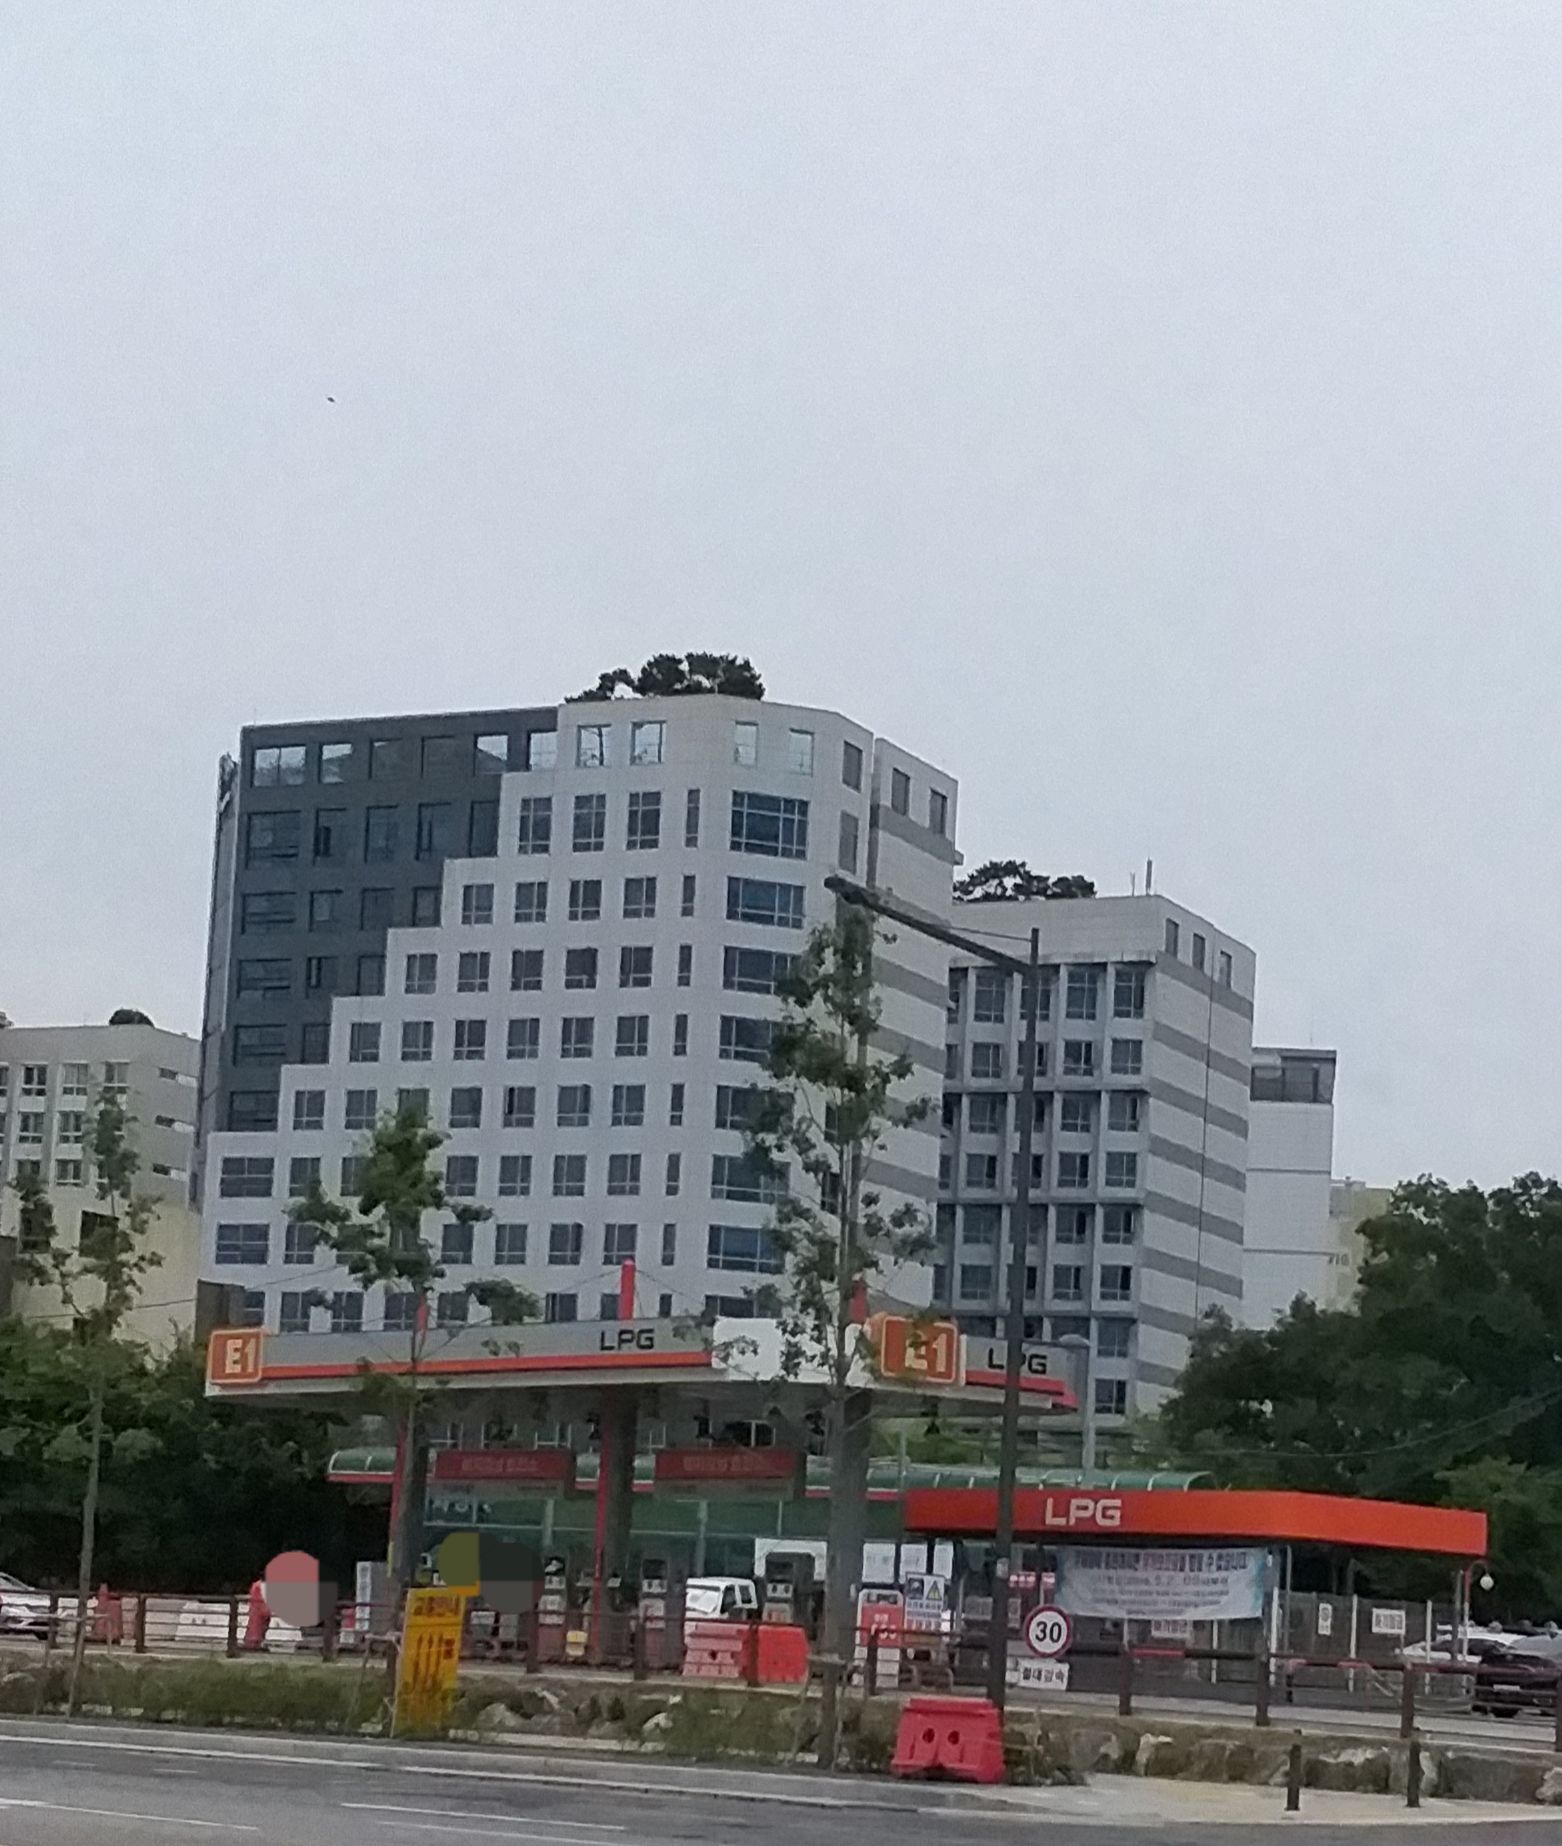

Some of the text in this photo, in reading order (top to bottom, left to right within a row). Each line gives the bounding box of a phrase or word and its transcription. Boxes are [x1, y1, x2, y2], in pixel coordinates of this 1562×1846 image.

[600, 1327, 655, 1351] LPG
[225, 1337, 257, 1374] E1
[988, 1347, 1048, 1375] LG
[1045, 1496, 1122, 1527] LPG
[1035, 1620, 1062, 1643] 30
